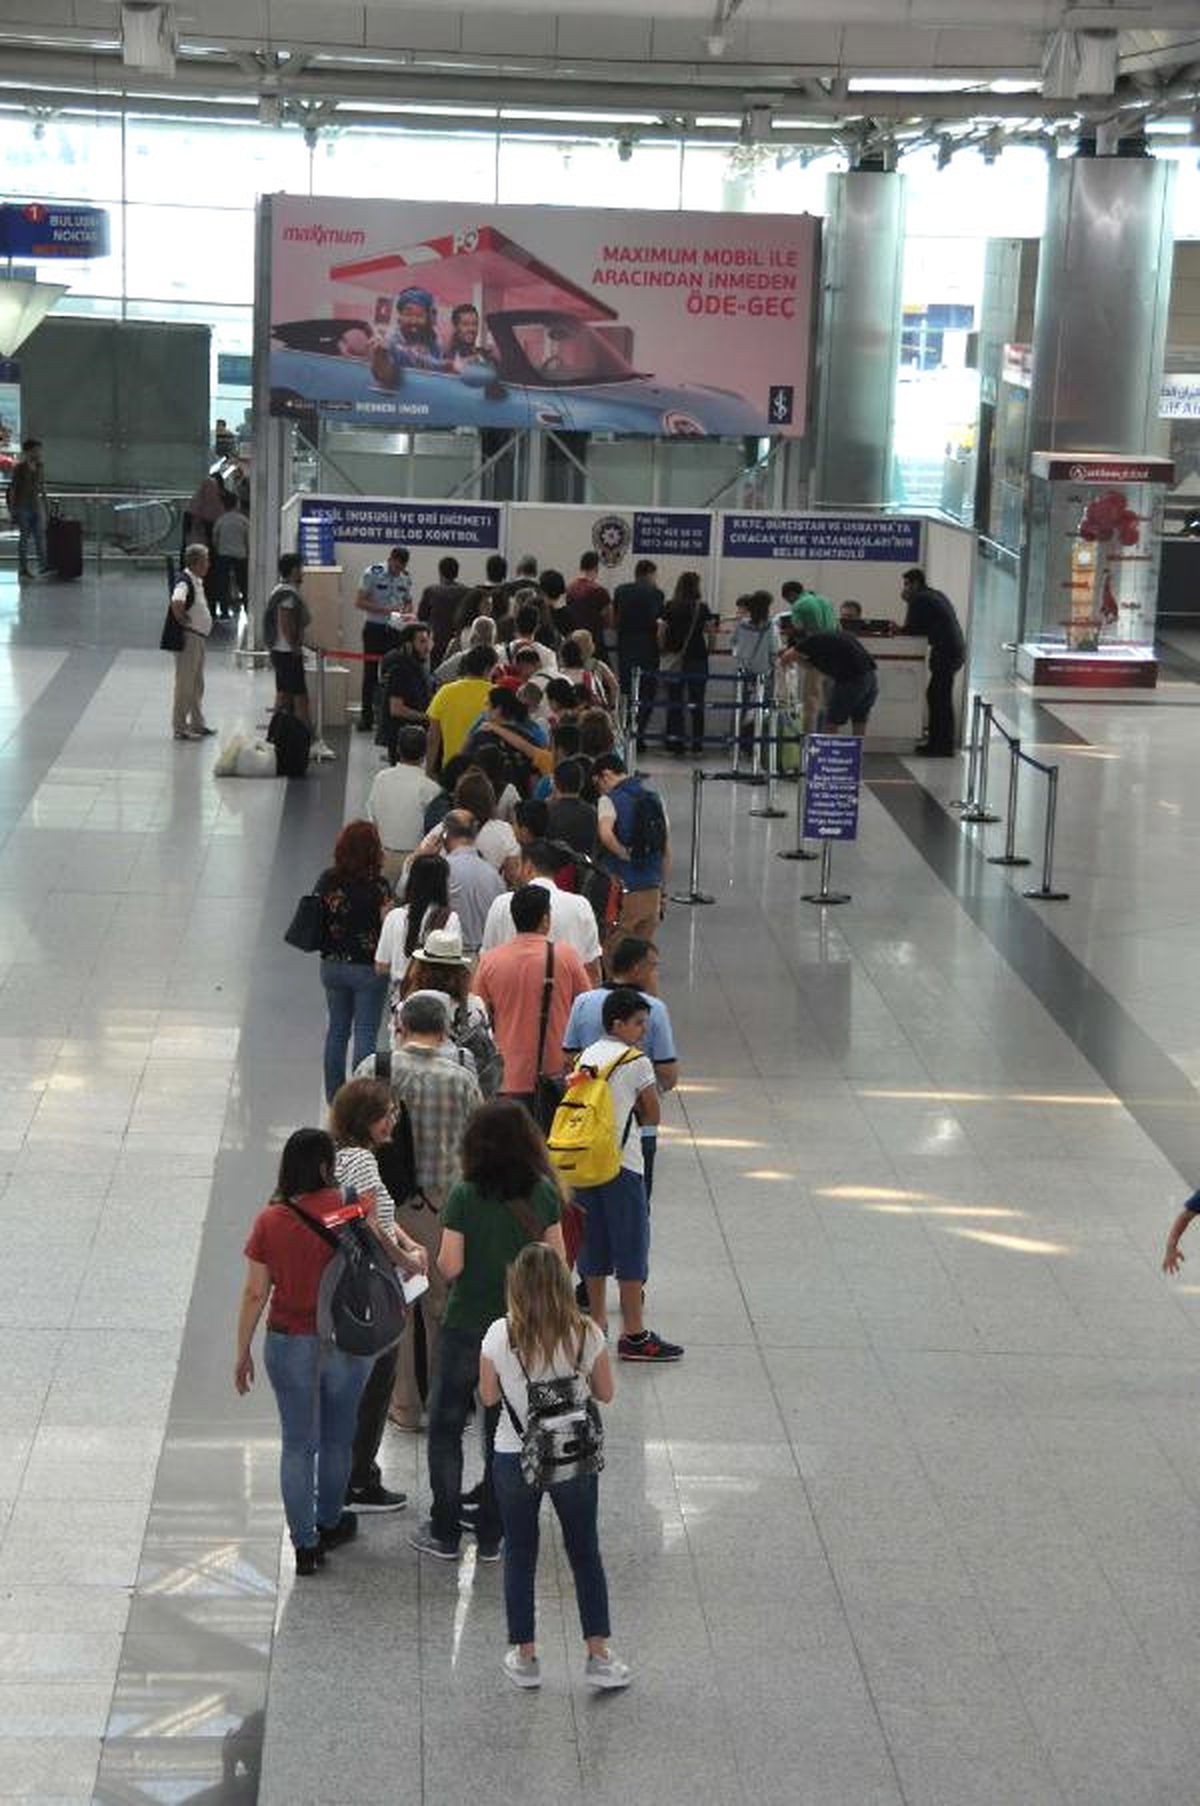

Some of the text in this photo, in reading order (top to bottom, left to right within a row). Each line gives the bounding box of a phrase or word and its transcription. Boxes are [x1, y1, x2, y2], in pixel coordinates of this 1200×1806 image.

[603, 245, 697, 265] MAXIMUM
[592, 268, 702, 288] ARACINDAN
[686, 289, 796, 319] ÖDE-GEÇ
